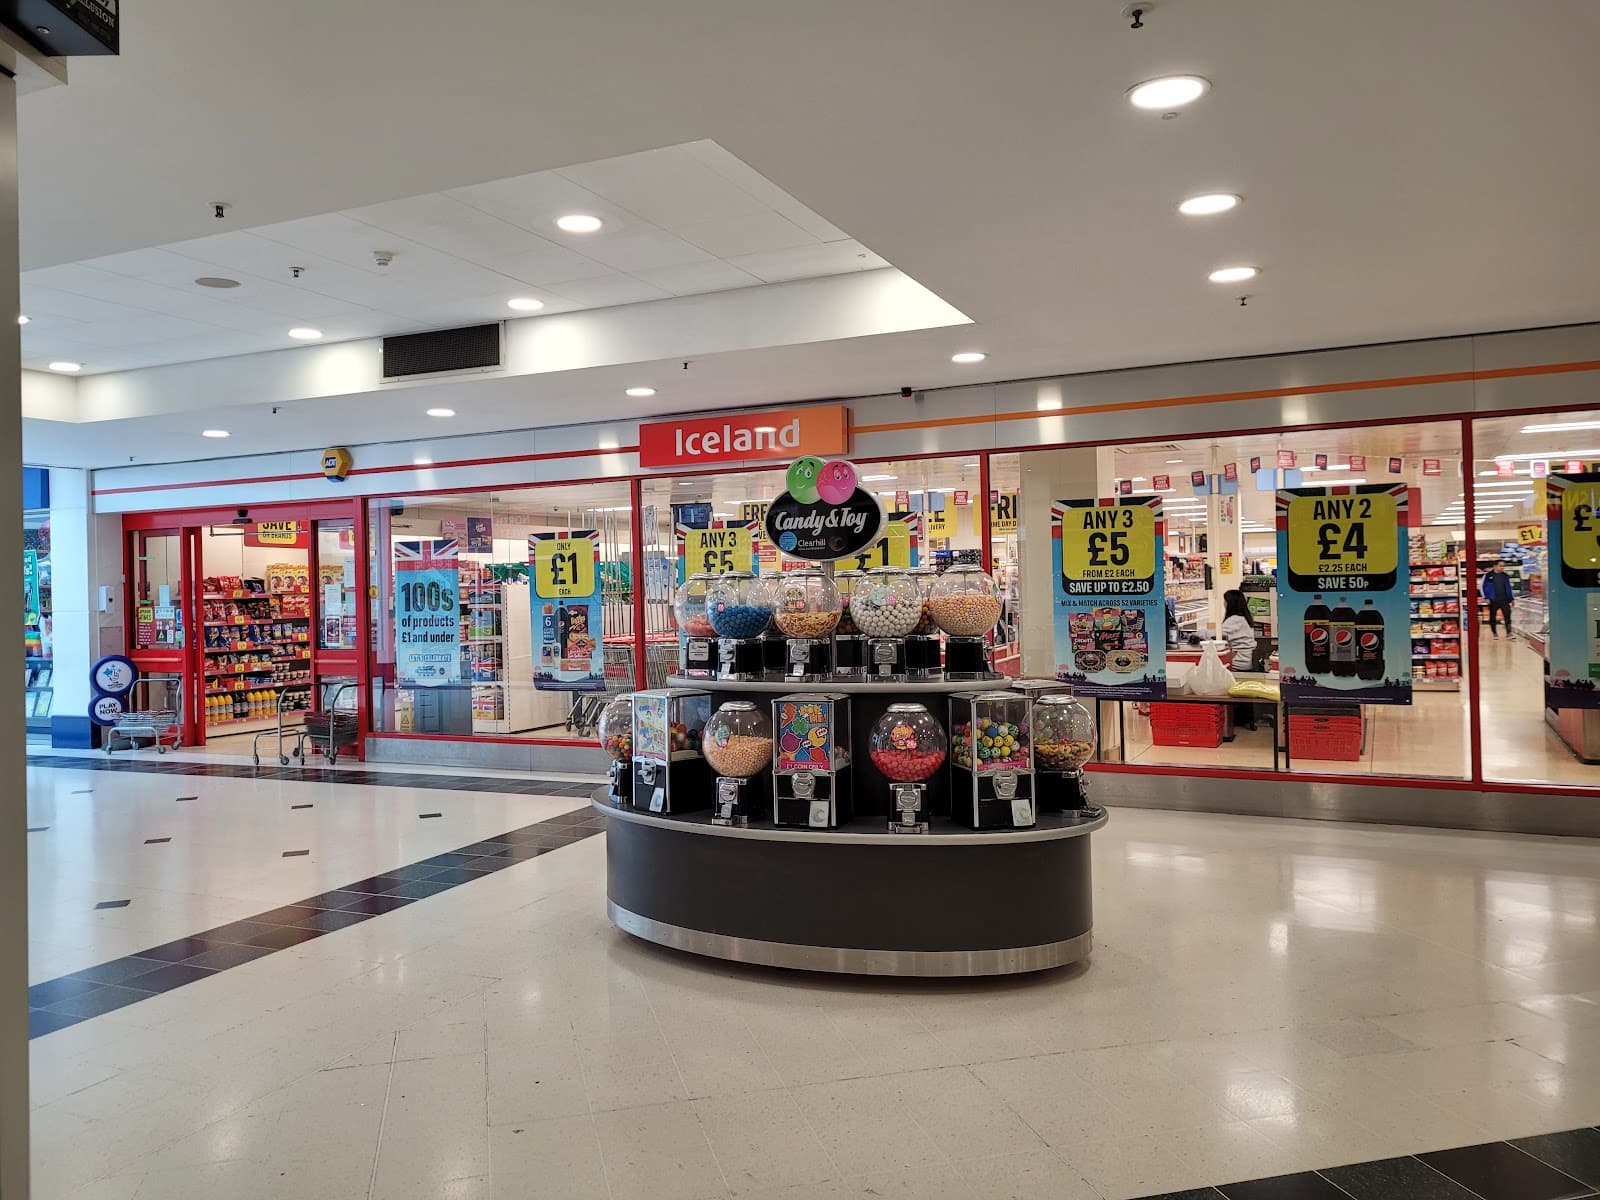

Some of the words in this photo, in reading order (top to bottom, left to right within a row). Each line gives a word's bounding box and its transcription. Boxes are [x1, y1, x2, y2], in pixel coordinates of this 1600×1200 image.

[80, 0, 115, 28] LLUSION
[675, 418, 800, 457] Iceland
[1313, 499, 1354, 520] ANY
[1359, 498, 1372, 518] 2
[1083, 510, 1118, 529] ANY
[1122, 509, 1134, 529] 3
[556, 542, 571, 551] ONLY
[700, 532, 726, 548] ANY
[728, 531, 737, 548] 3
[797, 538, 826, 548] Clearhill
[1317, 522, 1368, 560] £4
[1087, 531, 1130, 566] £5
[550, 552, 578, 585] £1
[703, 550, 734, 574] £5
[1318, 563, 1343, 573] £2.25
[1345, 563, 1367, 572] EACH
[1082, 570, 1103, 578] FROM
[1104, 569, 1114, 577] £2
[1115, 568, 1135, 577] EACH
[1069, 581, 1092, 593] SAVE
[1093, 581, 1107, 593] UP
[1107, 581, 1120, 593] TO
[1121, 581, 1150, 593] £2.50
[1318, 577, 1346, 589] SAVE
[400, 581, 454, 612] 100s
[558, 588, 571, 596] EACH
[401, 614, 411, 627] of
[412, 614, 455, 630] products
[544, 616, 552, 626] 6
[401, 631, 412, 643] £1
[412, 631, 428, 643] and
[429, 631, 455, 643] under
[99, 707, 119, 715] NOW
